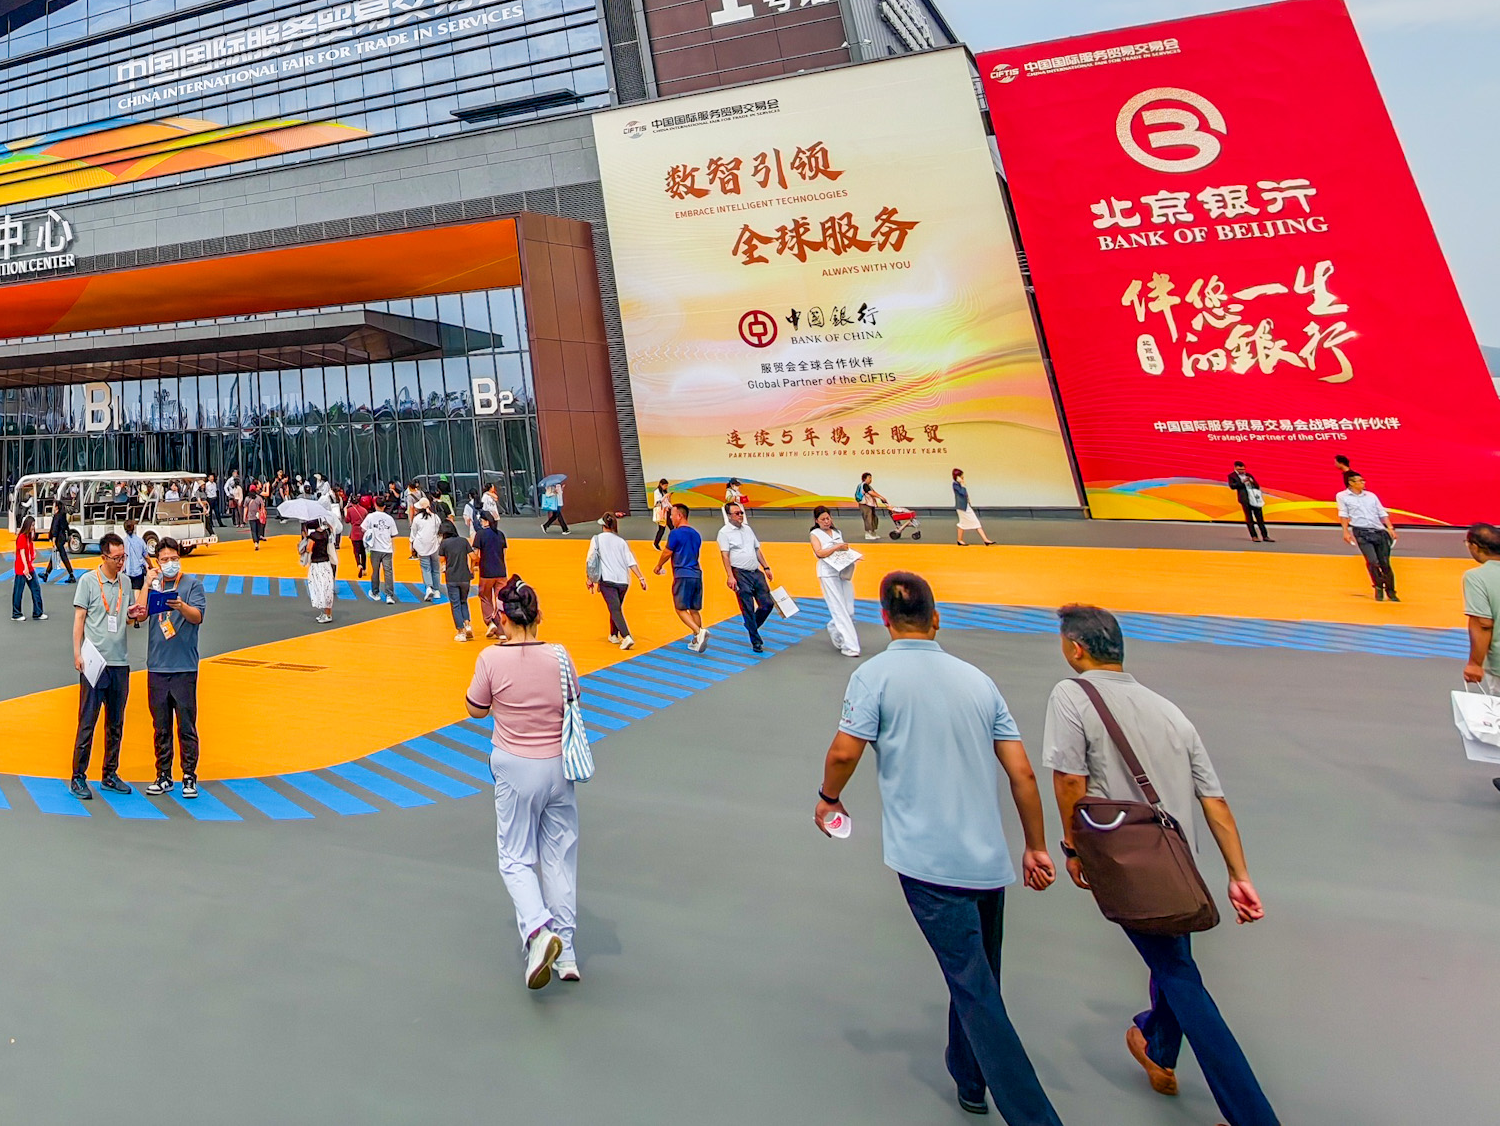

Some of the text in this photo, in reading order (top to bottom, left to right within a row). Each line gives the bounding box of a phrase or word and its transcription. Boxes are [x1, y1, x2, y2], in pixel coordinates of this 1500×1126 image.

[118, 5, 524, 109] CHINA INTERNATIONAL FAIR FOR TRADE IN SERVICES
[1024, 38, 1180, 72] 中国国际服务贸易交易会
[990, 68, 1019, 79] CIFTIS
[651, 98, 780, 128] 中国国际服务贸易交易会
[623, 125, 647, 135] CIFTIS
[664, 140, 846, 200] 数智引领
[674, 189, 848, 219] EMBRACE INTELLIGENT TECHNOLOGIES
[731, 206, 921, 266] 全球服务
[1097, 216, 1329, 251] BANK OF BEIJING
[28, 253, 76, 272] CENTER
[821, 260, 911, 277] ALWAYS WITH YOU
[791, 331, 883, 345] BANK OF CHINA
[760, 356, 874, 374] 服贸会全球合作伙伴
[747, 372, 897, 390] Global Partner of the CIFTIS
[472, 377, 516, 414] B2
[1153, 417, 1401, 433] 中国国际服务贸易交易会战略合作伙伴
[725, 424, 945, 449] 连续5年携手服贸
[1207, 432, 1347, 442] Strategic Partner of the CIFTIS
[860, 448, 917, 456] CONSECUTIVE
